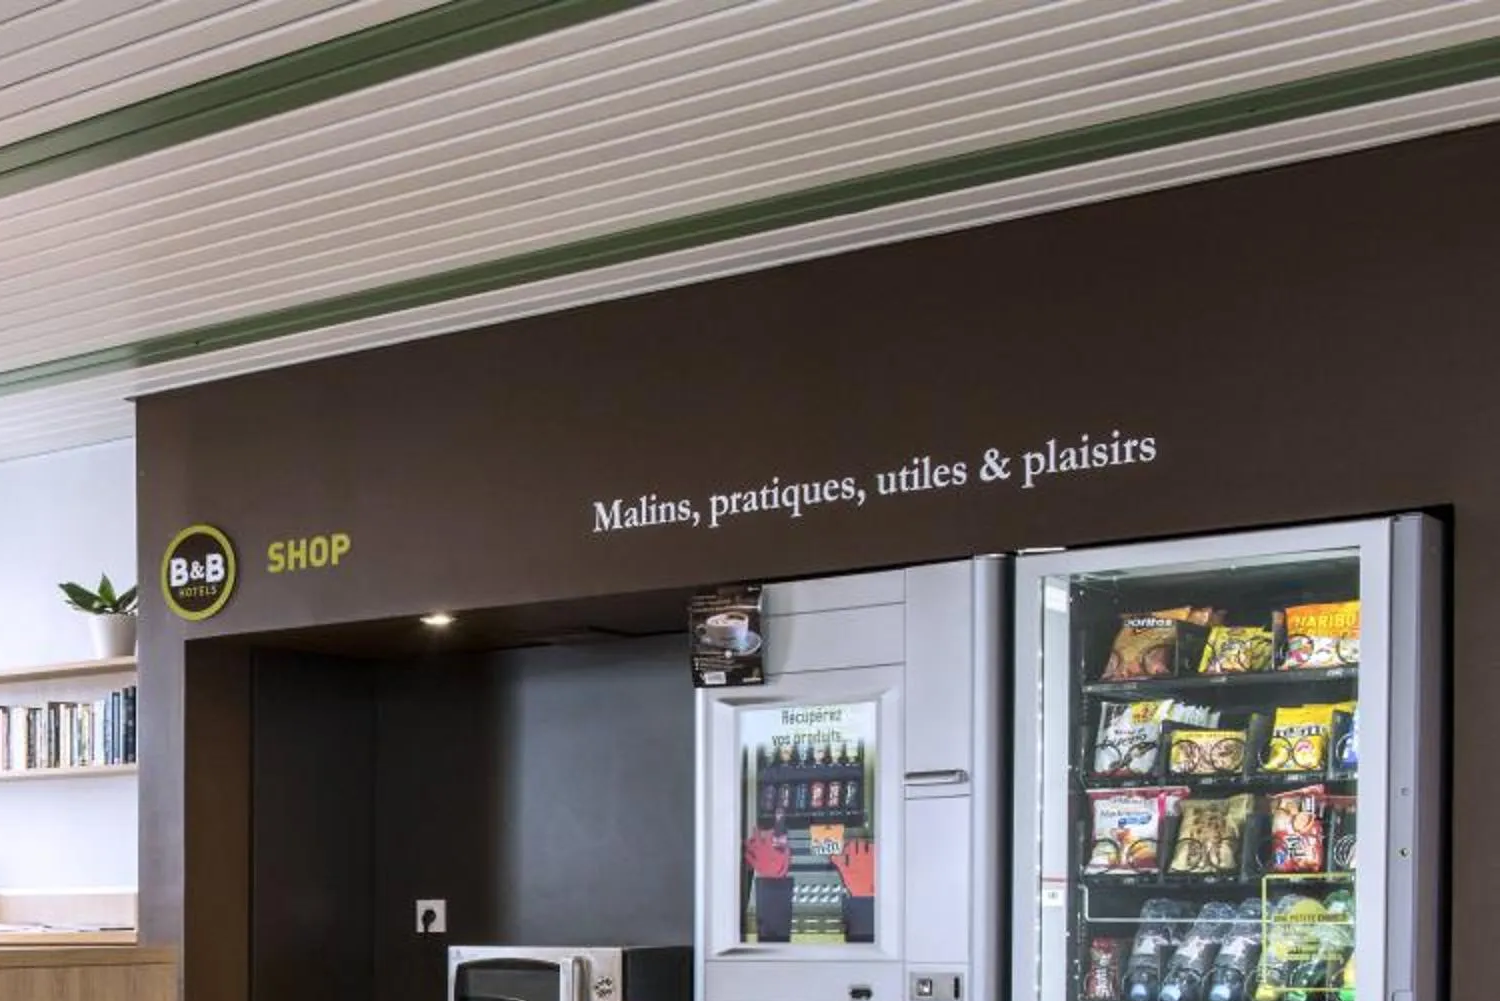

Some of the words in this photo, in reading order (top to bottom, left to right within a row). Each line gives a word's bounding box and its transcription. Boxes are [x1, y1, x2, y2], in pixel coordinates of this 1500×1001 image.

[592, 493, 701, 533] Malins,
[707, 476, 867, 529] pratiques,
[876, 455, 968, 496] utiles
[979, 447, 1012, 482] &
[1020, 429, 1158, 489] plaisirs
[169, 553, 226, 588] B&B
[267, 532, 351, 574] SHOP
[178, 584, 218, 599] HOTELS
